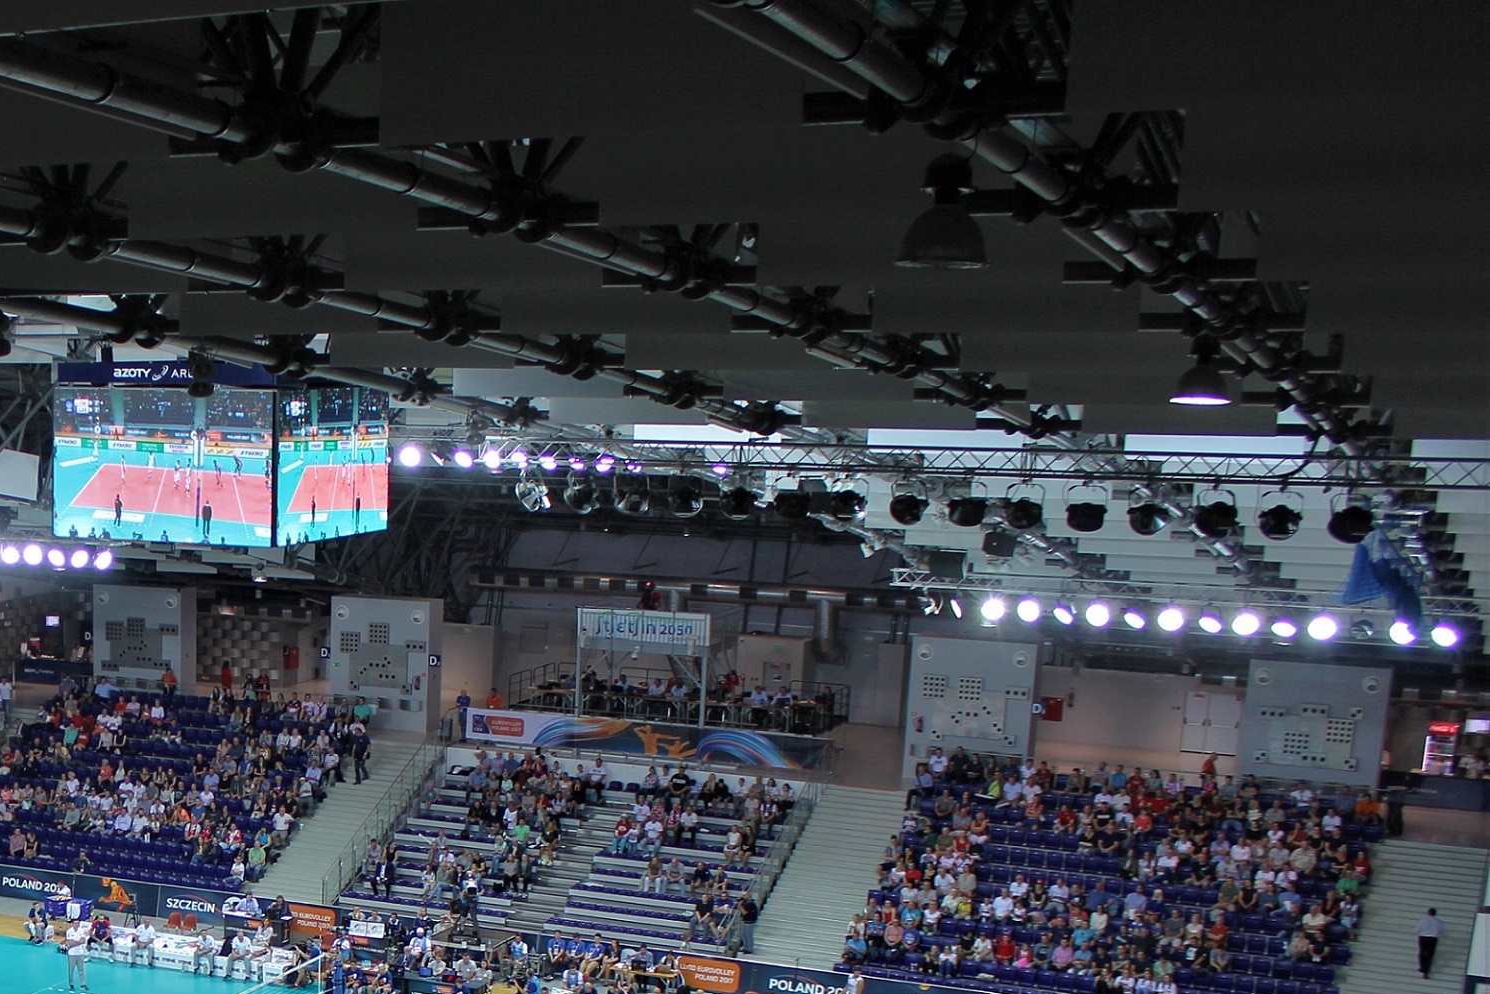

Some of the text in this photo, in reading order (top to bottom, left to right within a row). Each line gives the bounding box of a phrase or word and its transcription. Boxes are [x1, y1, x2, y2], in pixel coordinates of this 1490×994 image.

[113, 368, 151, 378] AZOTY
[659, 623, 693, 636] 2050
[2, 876, 61, 893] POLAND 201
[166, 897, 216, 914] SZCZECIN
[297, 919, 318, 928] POLAND
[298, 913, 331, 922] EUROVOLLEY
[697, 965, 736, 977] EUROVOLLEY
[694, 973, 734, 985] POLAND 2017
